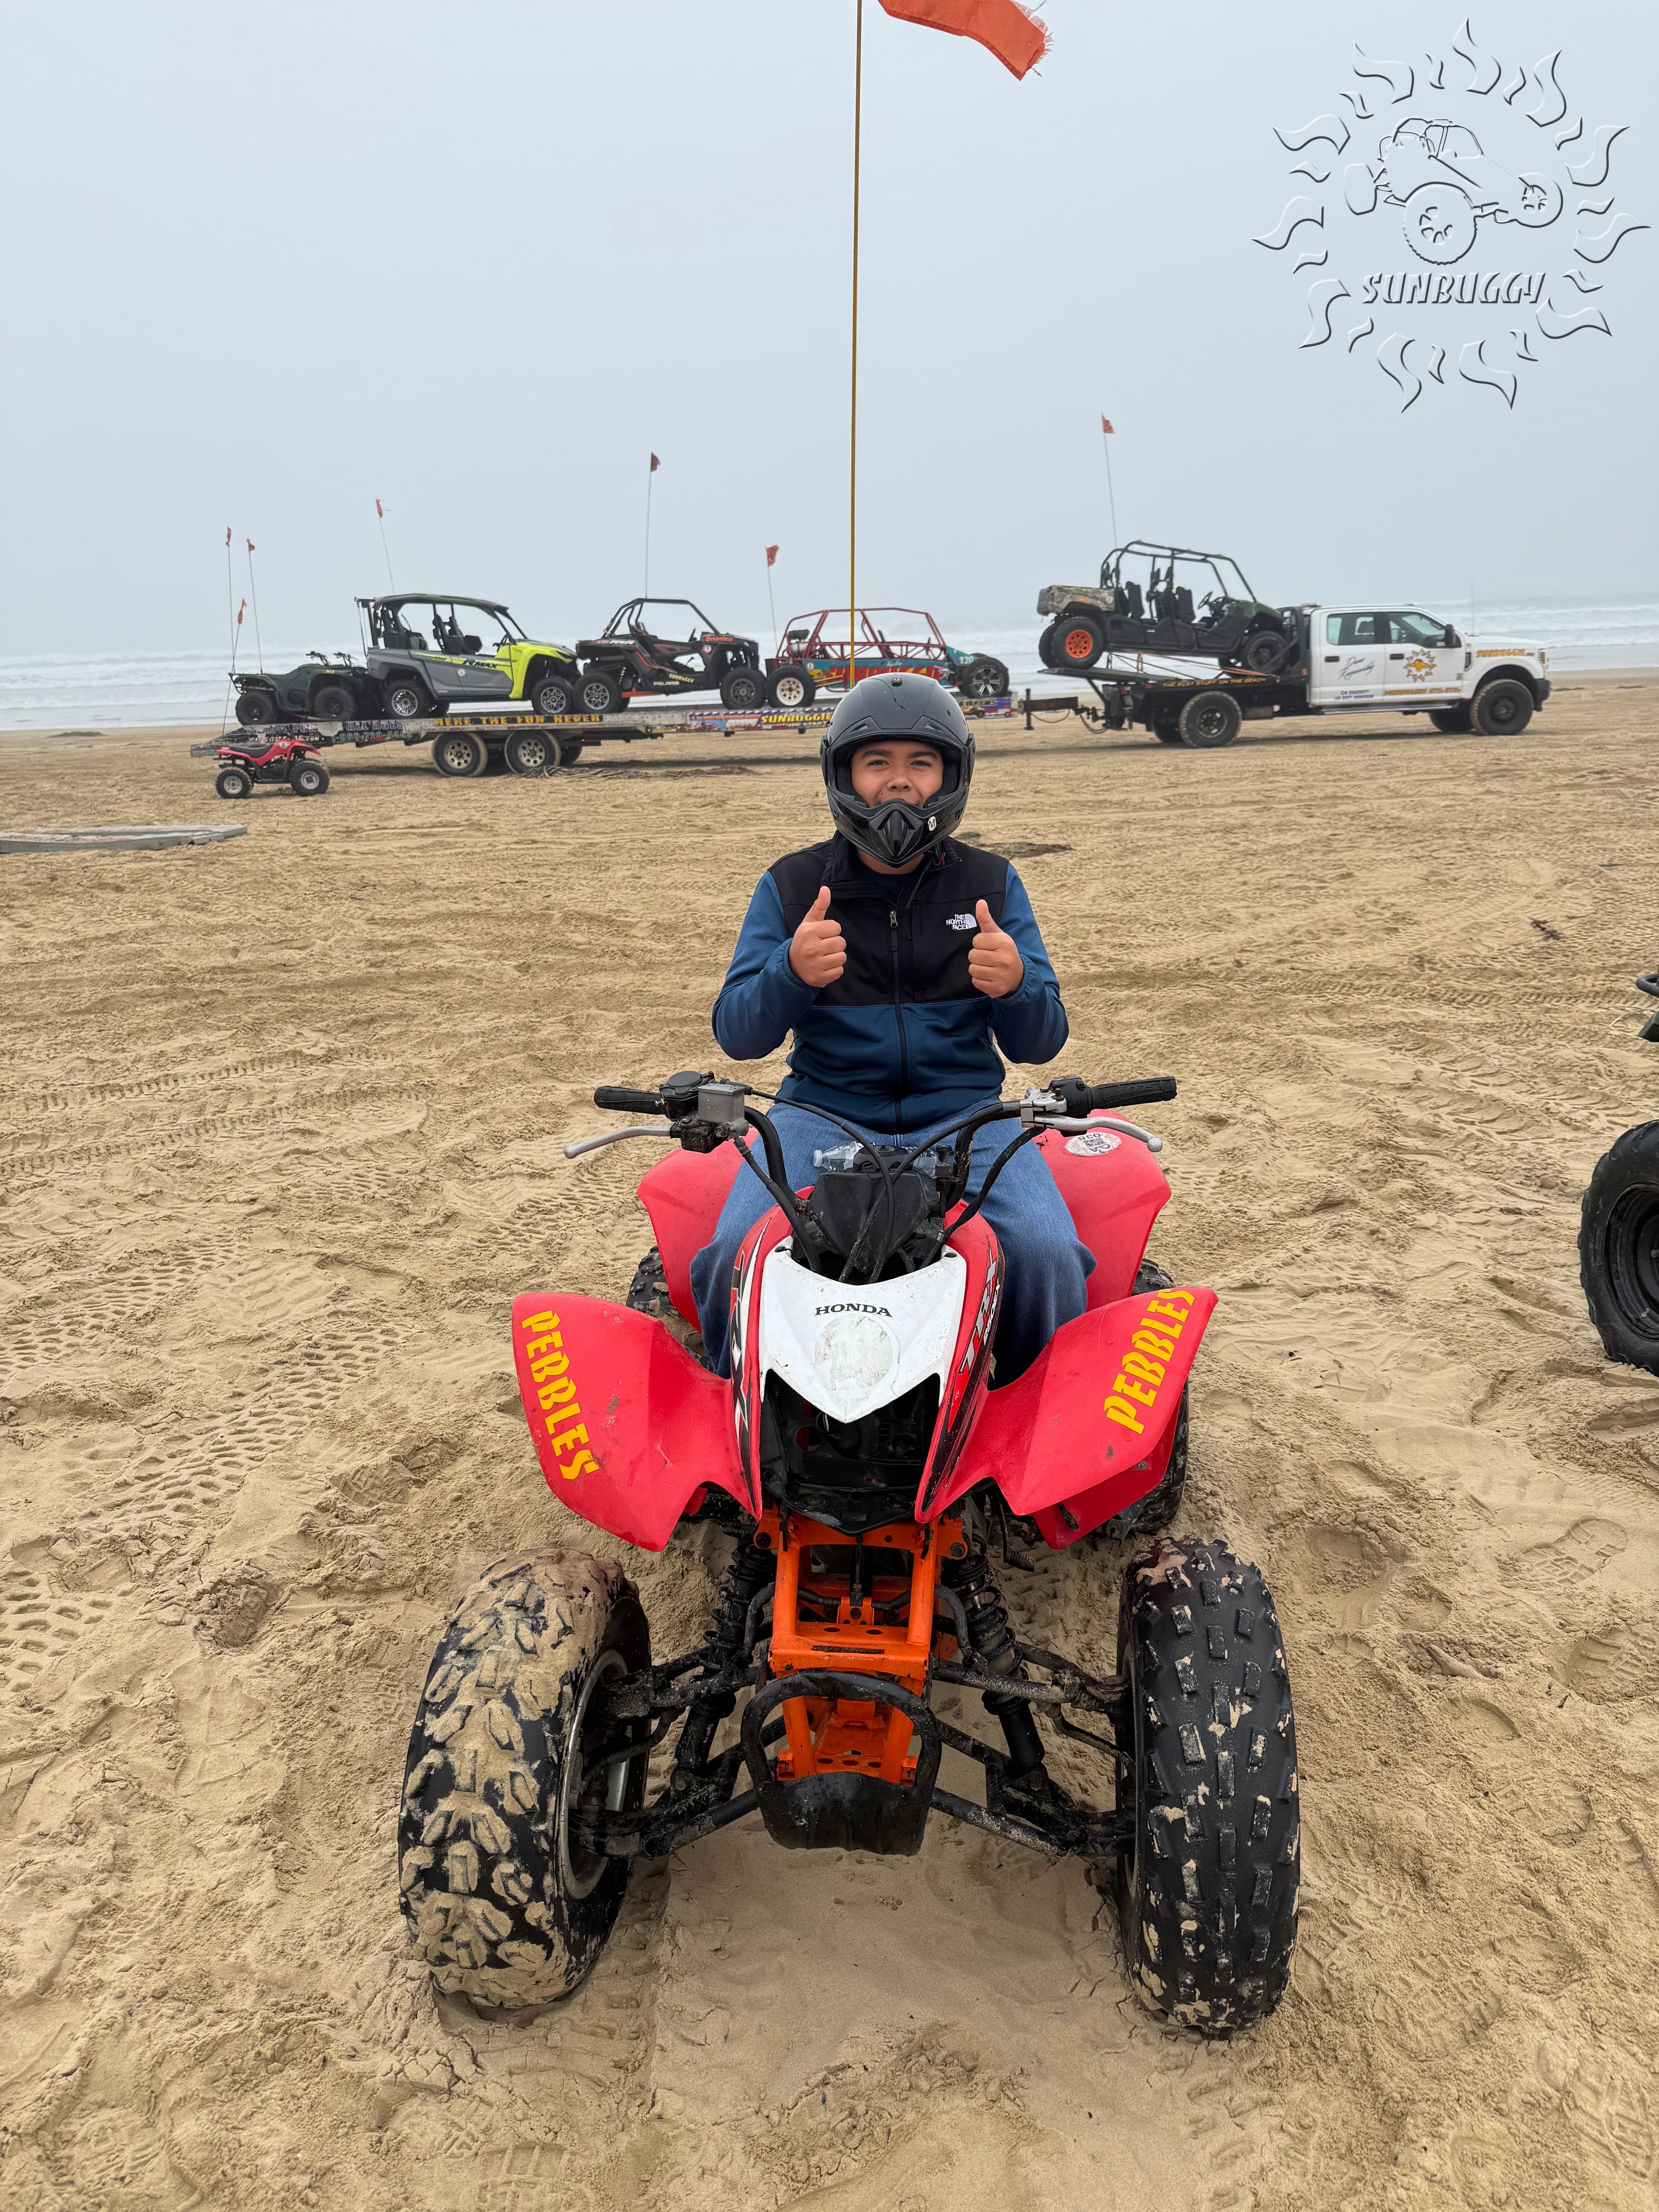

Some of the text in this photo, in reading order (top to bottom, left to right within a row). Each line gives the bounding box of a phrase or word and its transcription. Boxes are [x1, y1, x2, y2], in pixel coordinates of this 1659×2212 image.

[814, 1303, 893, 1317] HONDA
[958, 1246, 997, 1374] TRX
[983, 1277, 1001, 1345] 250EX
[1103, 1289, 1195, 1435] PEBBLES
[521, 1310, 600, 1480] PEBBLES
